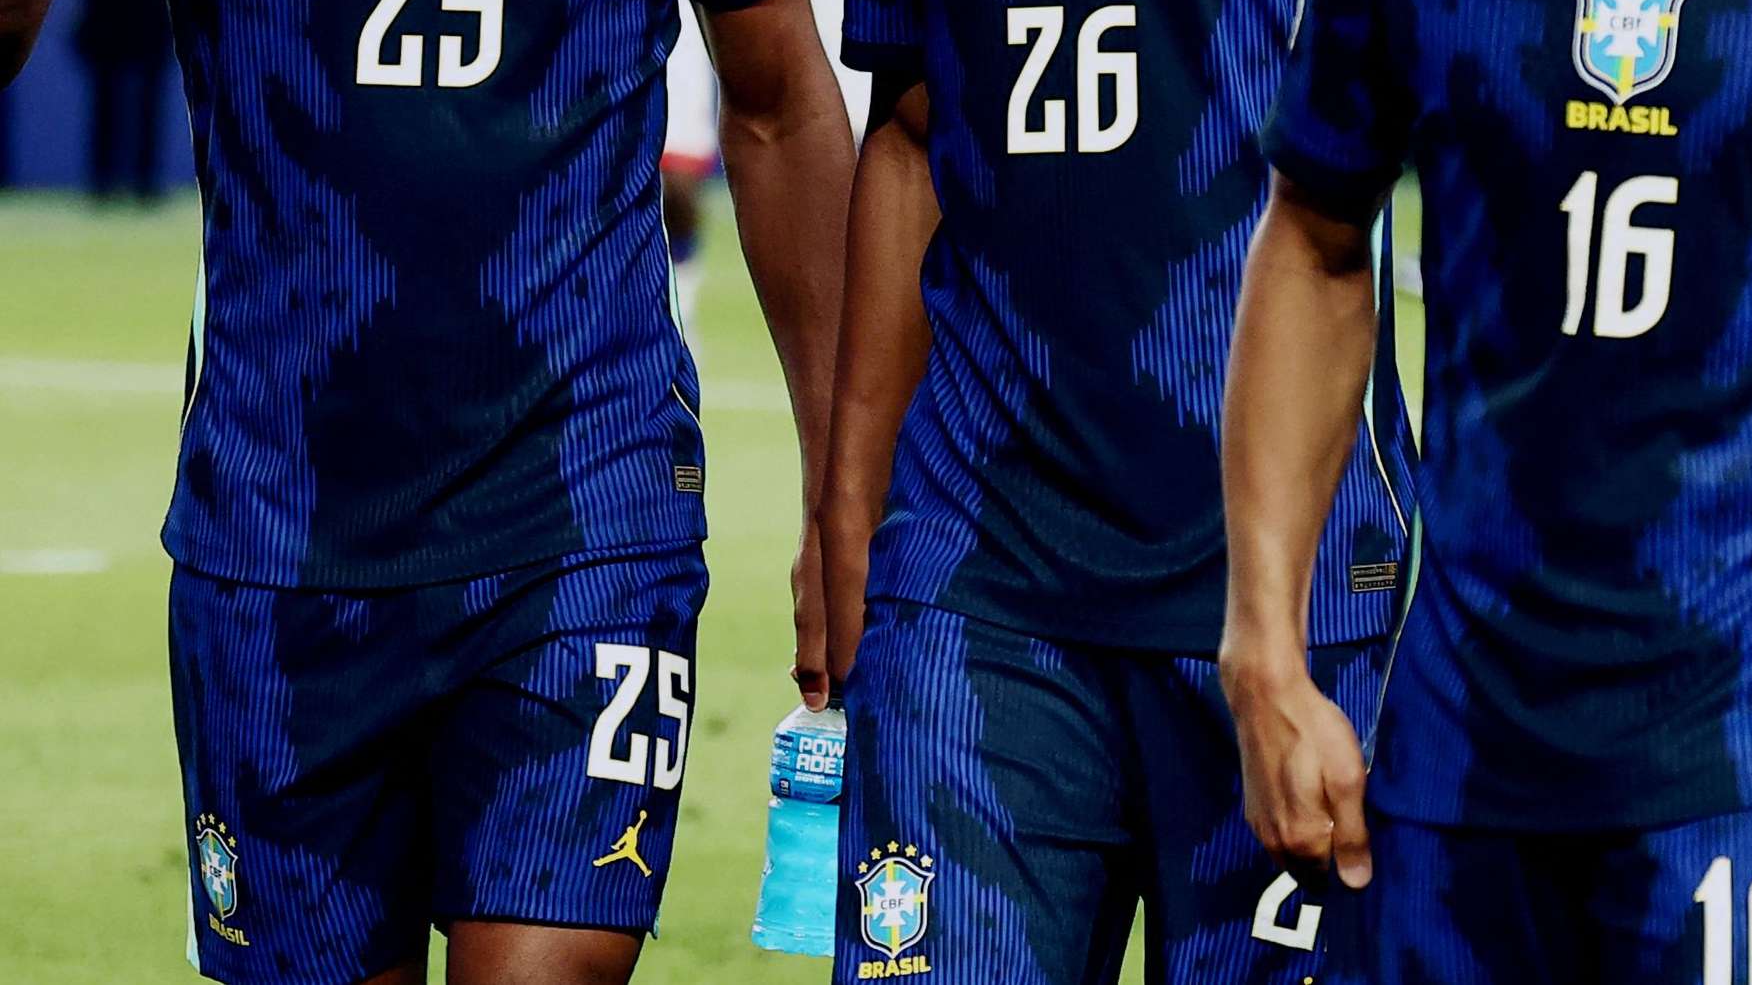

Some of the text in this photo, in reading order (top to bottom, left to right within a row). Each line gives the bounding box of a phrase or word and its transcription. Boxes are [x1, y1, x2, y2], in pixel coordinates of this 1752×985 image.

[1006, 4, 1140, 155] 26
[1565, 100, 1678, 136] BRASIL
[1560, 170, 1679, 339] 16
[586, 642, 689, 790] 25
[880, 898, 904, 911] CBF
[858, 955, 931, 979] BRASIL
